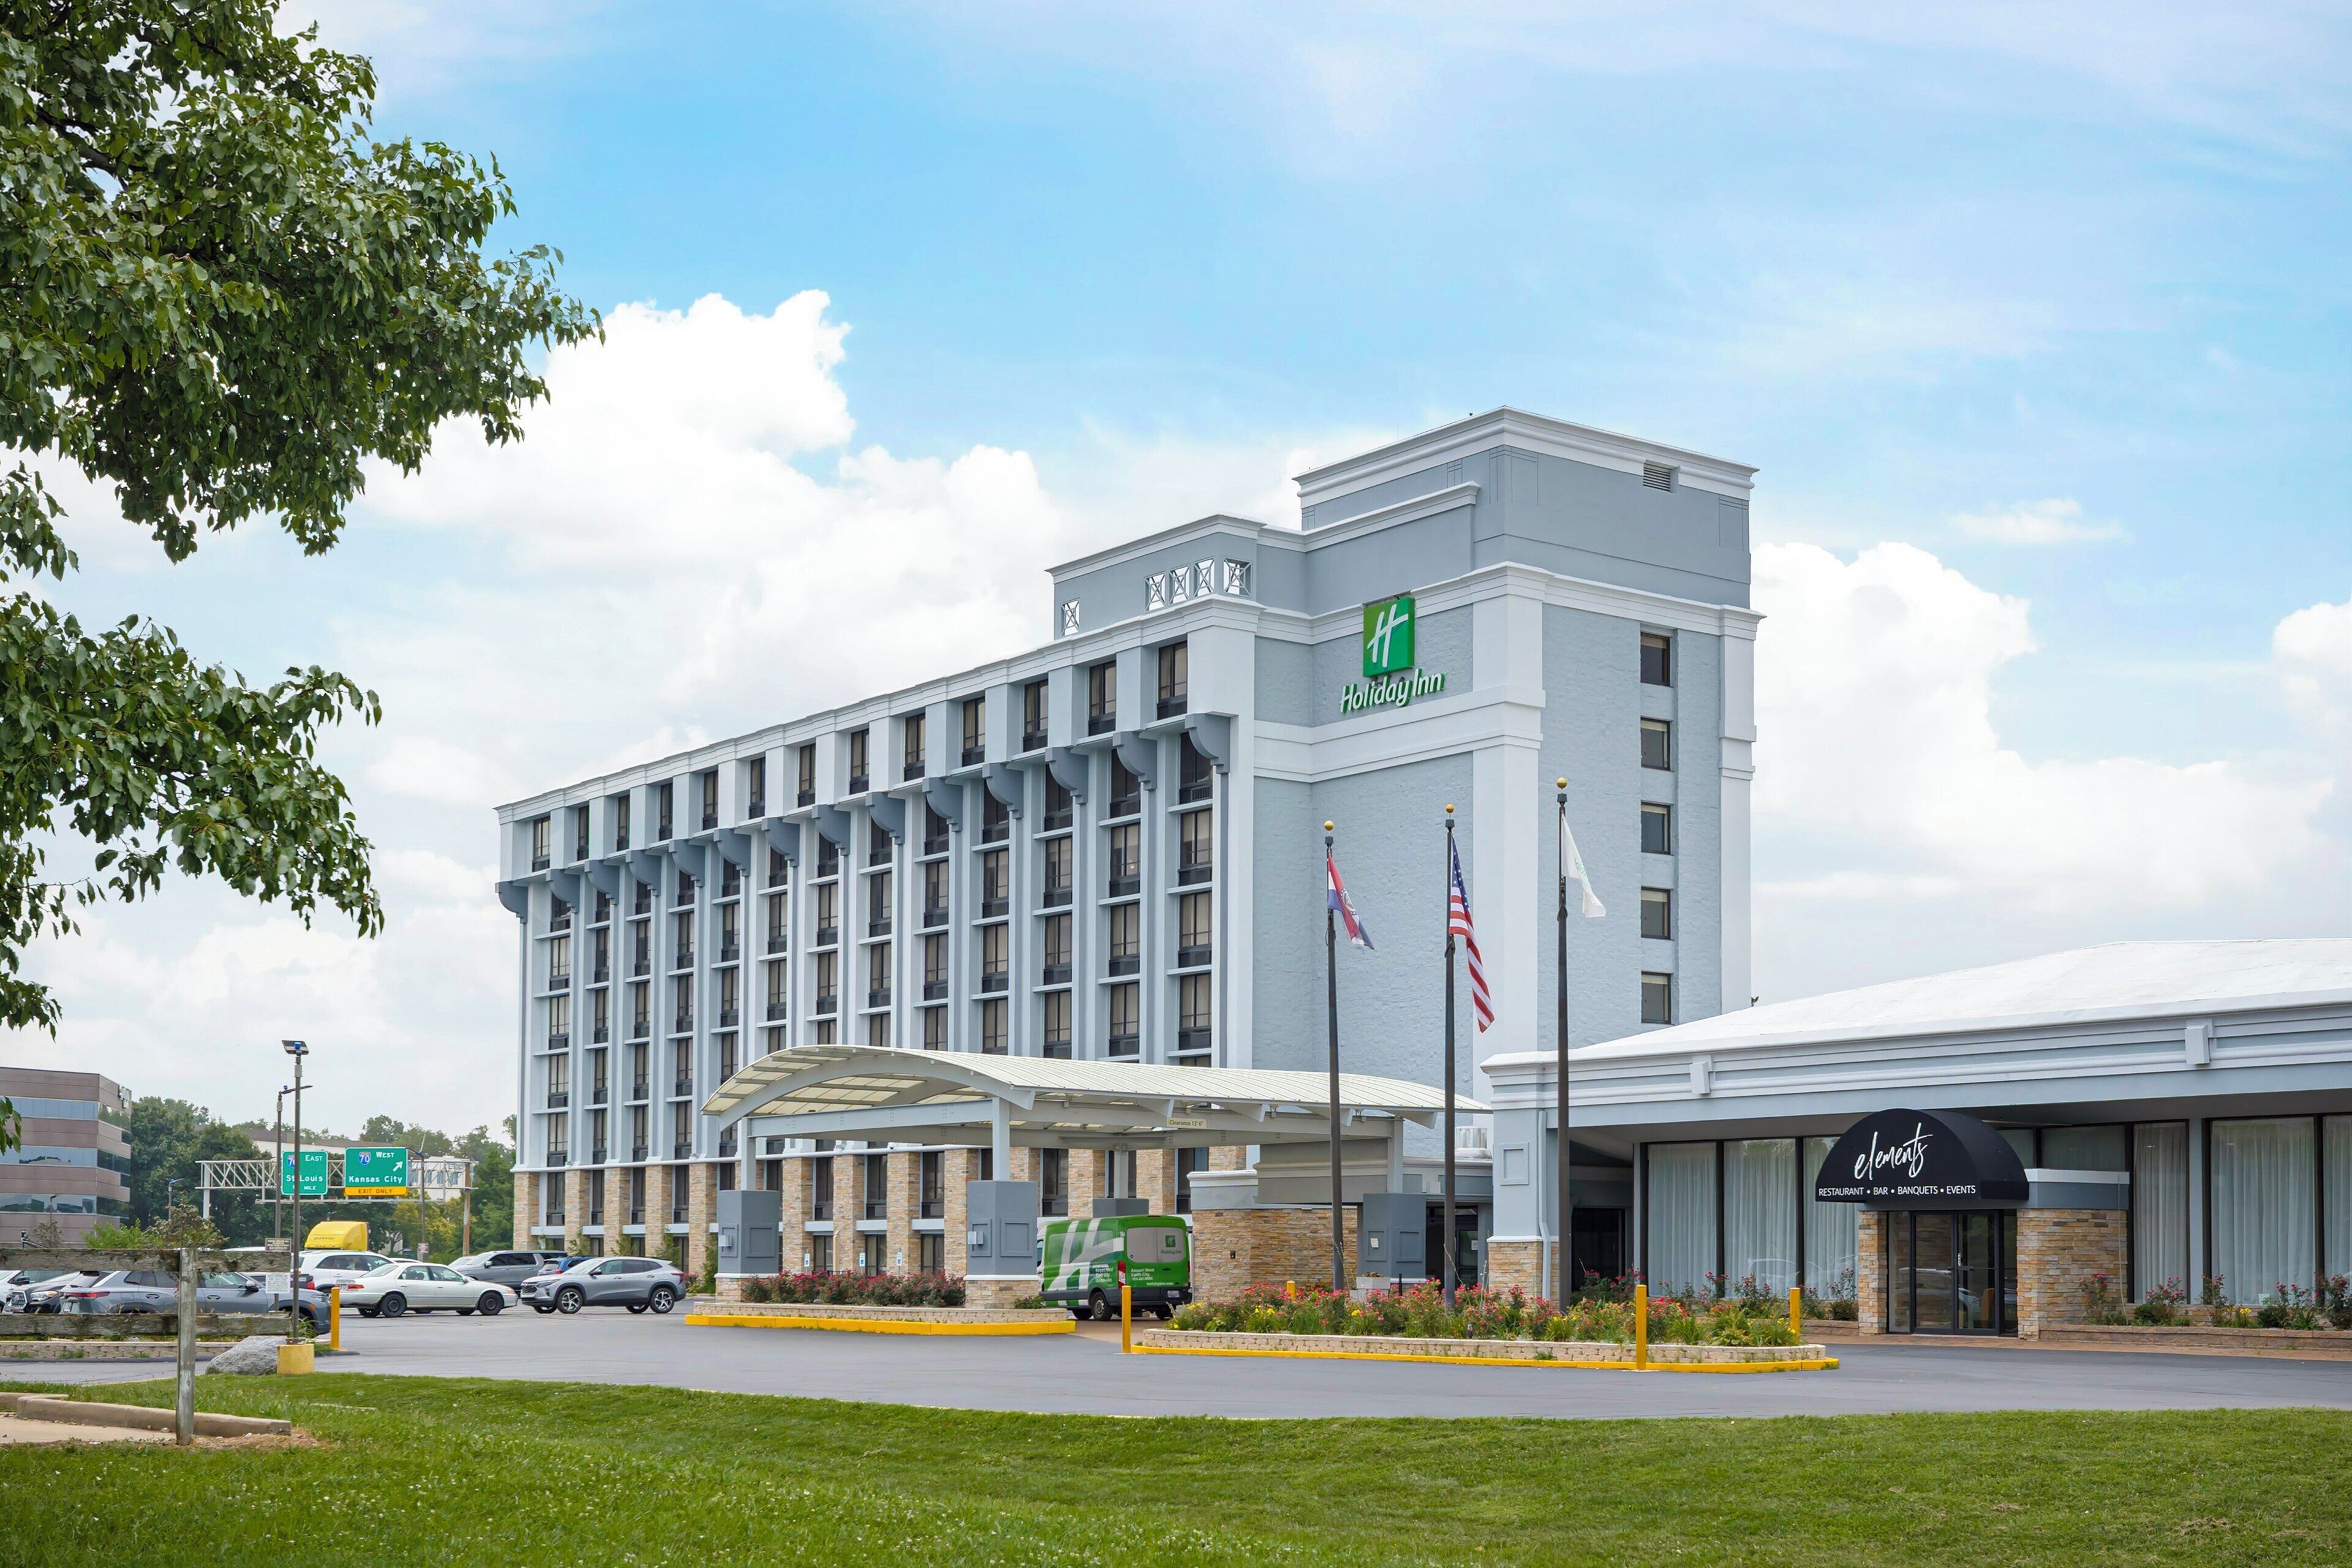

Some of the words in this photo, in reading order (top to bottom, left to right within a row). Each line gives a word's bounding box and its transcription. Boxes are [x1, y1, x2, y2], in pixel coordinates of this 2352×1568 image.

[1339, 675, 1411, 714] Holiday
[1412, 668, 1445, 697] Inn
[1854, 1122, 1934, 1180] elements
[384, 1175, 402, 1184] City
[1819, 1186, 1864, 1196] RESTAURANT
[1873, 1186, 1888, 1196] BAR
[1898, 1185, 1938, 1196] BANQUETS
[1947, 1185, 1976, 1194] EVENTS
